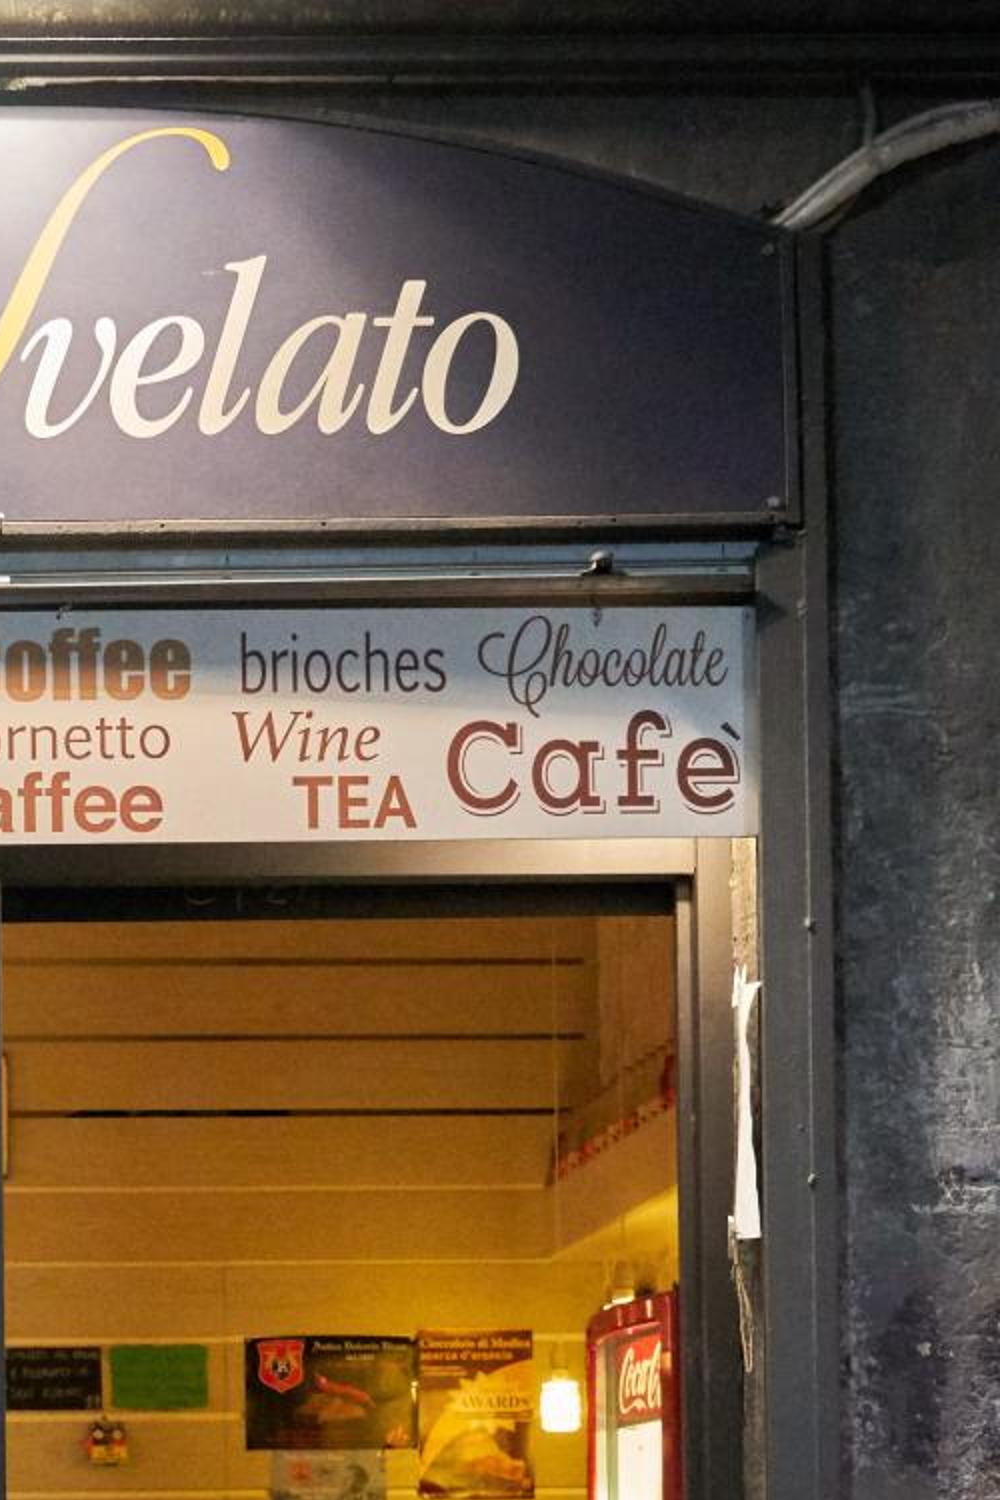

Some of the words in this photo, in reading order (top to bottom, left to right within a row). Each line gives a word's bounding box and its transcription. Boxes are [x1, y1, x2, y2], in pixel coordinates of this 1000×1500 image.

[240, 631, 447, 695] brioches
[477, 614, 730, 718] Chocolate
[233, 709, 381, 763] Wine
[446, 709, 742, 817] Cafè
[291, 776, 417, 830] TEA
[461, 1395, 530, 1409] AWARDS
